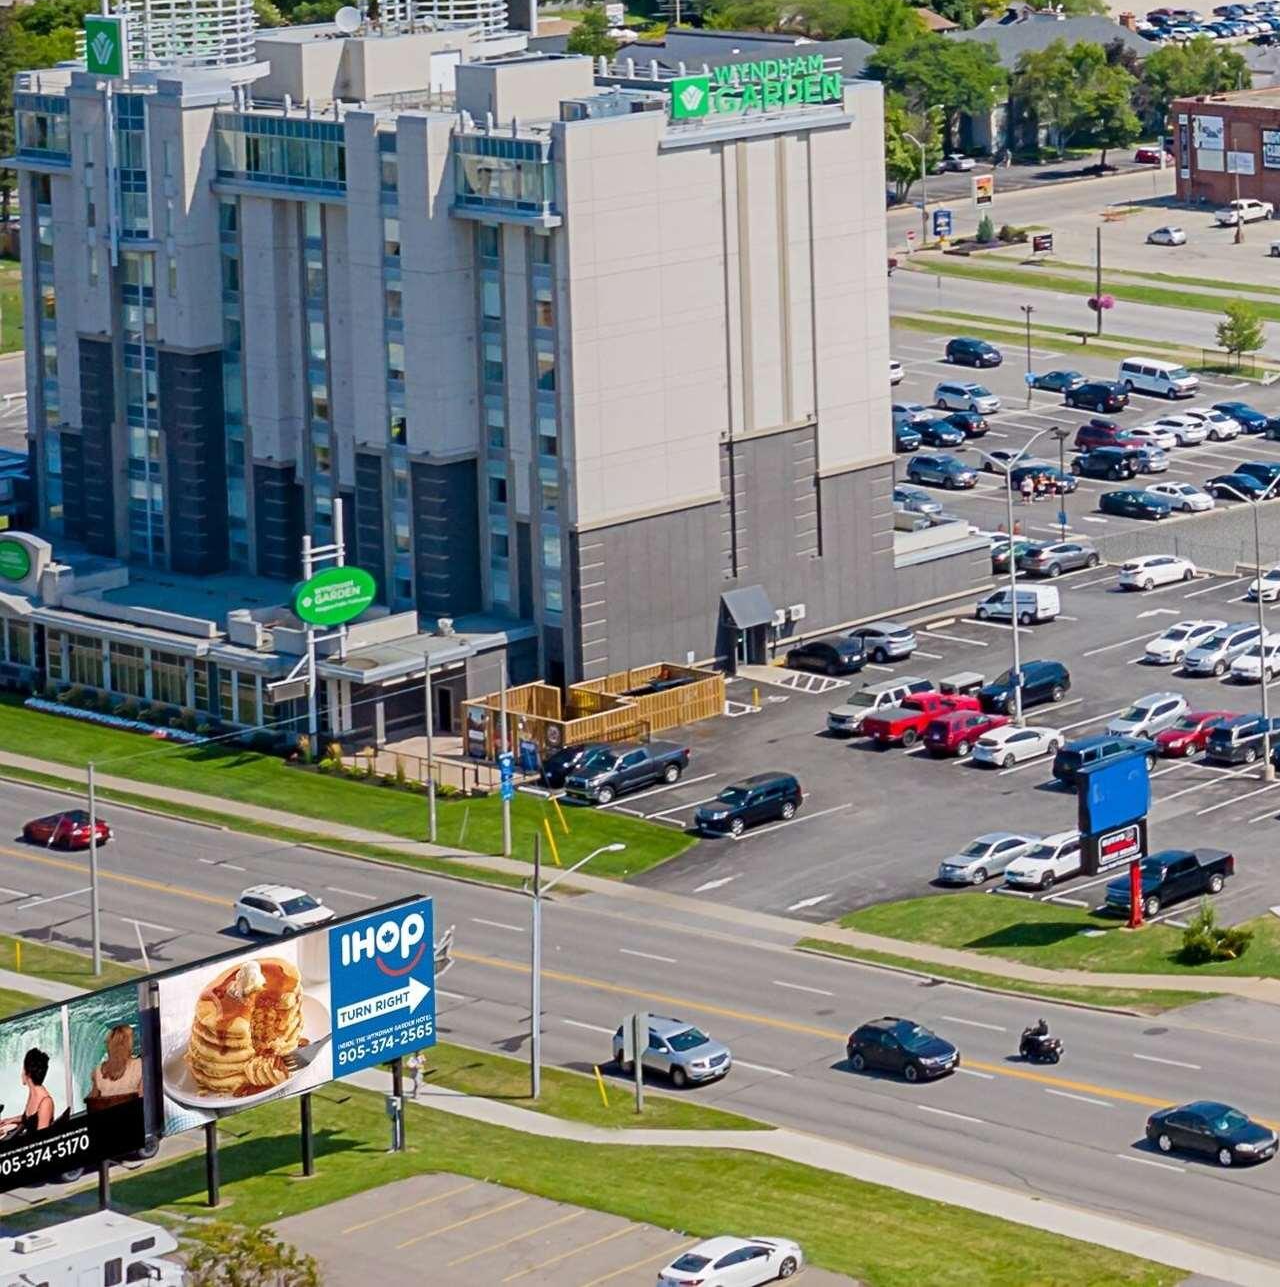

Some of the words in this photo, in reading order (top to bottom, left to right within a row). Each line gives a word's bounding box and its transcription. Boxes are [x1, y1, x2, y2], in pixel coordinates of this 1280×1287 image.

[714, 55, 824, 85] WYNDHAM
[716, 72, 843, 114] GARDEN
[314, 586, 361, 605] GARDEN
[342, 913, 425, 966] IHOP
[340, 1003, 371, 1023] TURN
[375, 991, 410, 1012] RIGHT
[339, 1022, 433, 1065] 905-374-2565
[356, 1034, 366, 1045] THE
[416, 1014, 432, 1025] HOTEL
[0, 1134, 89, 1175] 05-374-5170
